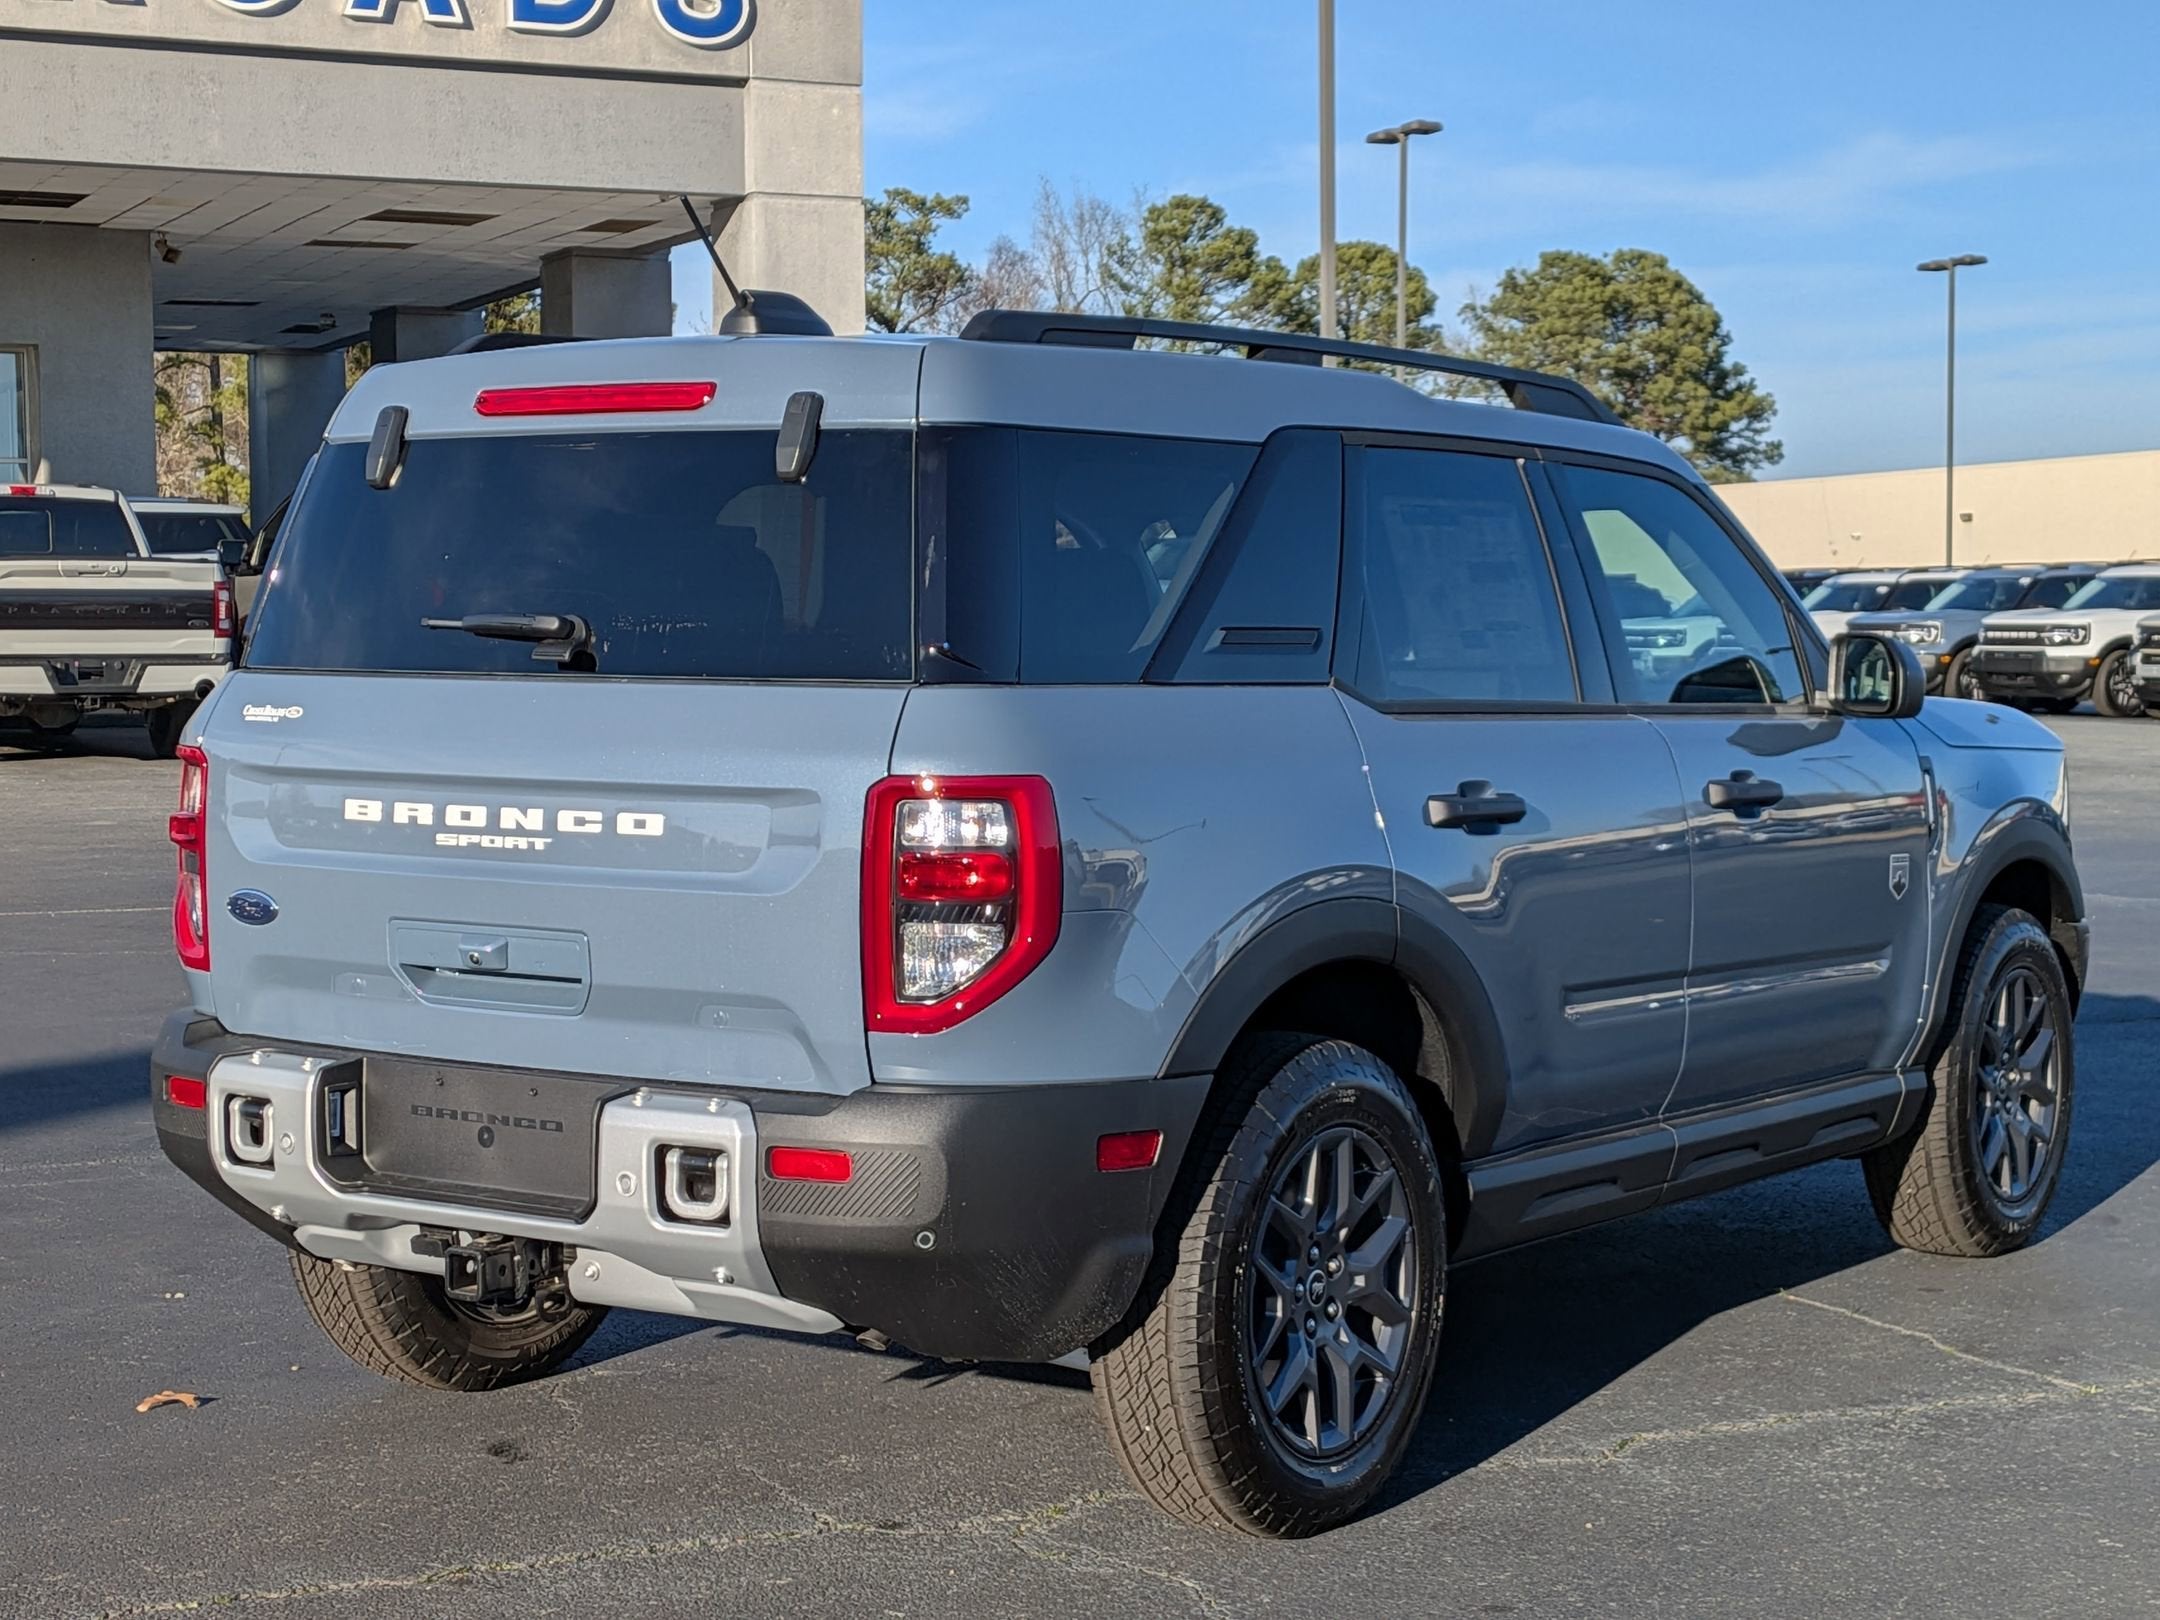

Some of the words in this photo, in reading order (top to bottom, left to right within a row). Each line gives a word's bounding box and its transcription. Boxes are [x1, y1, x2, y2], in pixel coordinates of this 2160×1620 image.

[344, 798, 665, 836] BRONCO
[435, 832, 553, 850] SPORT
[410, 1104, 564, 1133] BRONCO
